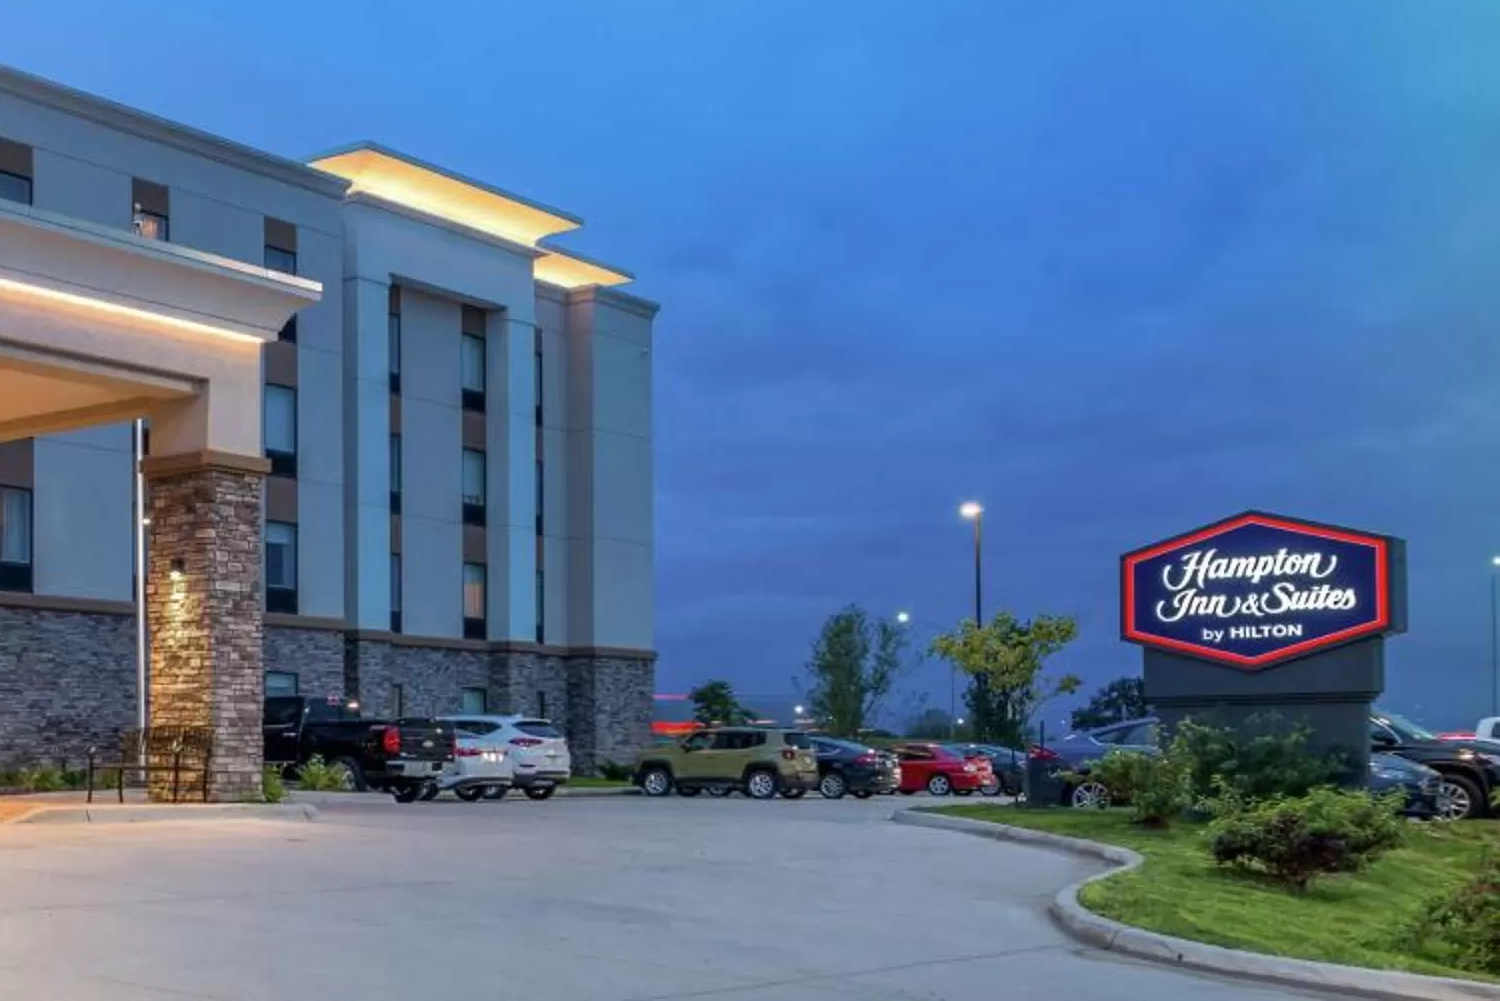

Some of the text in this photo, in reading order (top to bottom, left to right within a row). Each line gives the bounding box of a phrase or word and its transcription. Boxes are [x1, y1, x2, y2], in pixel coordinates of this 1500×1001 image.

[1162, 548, 1337, 591] Hampton
[1156, 582, 1357, 622] Inn & Suites
[1202, 624, 1303, 643] by HILTON
